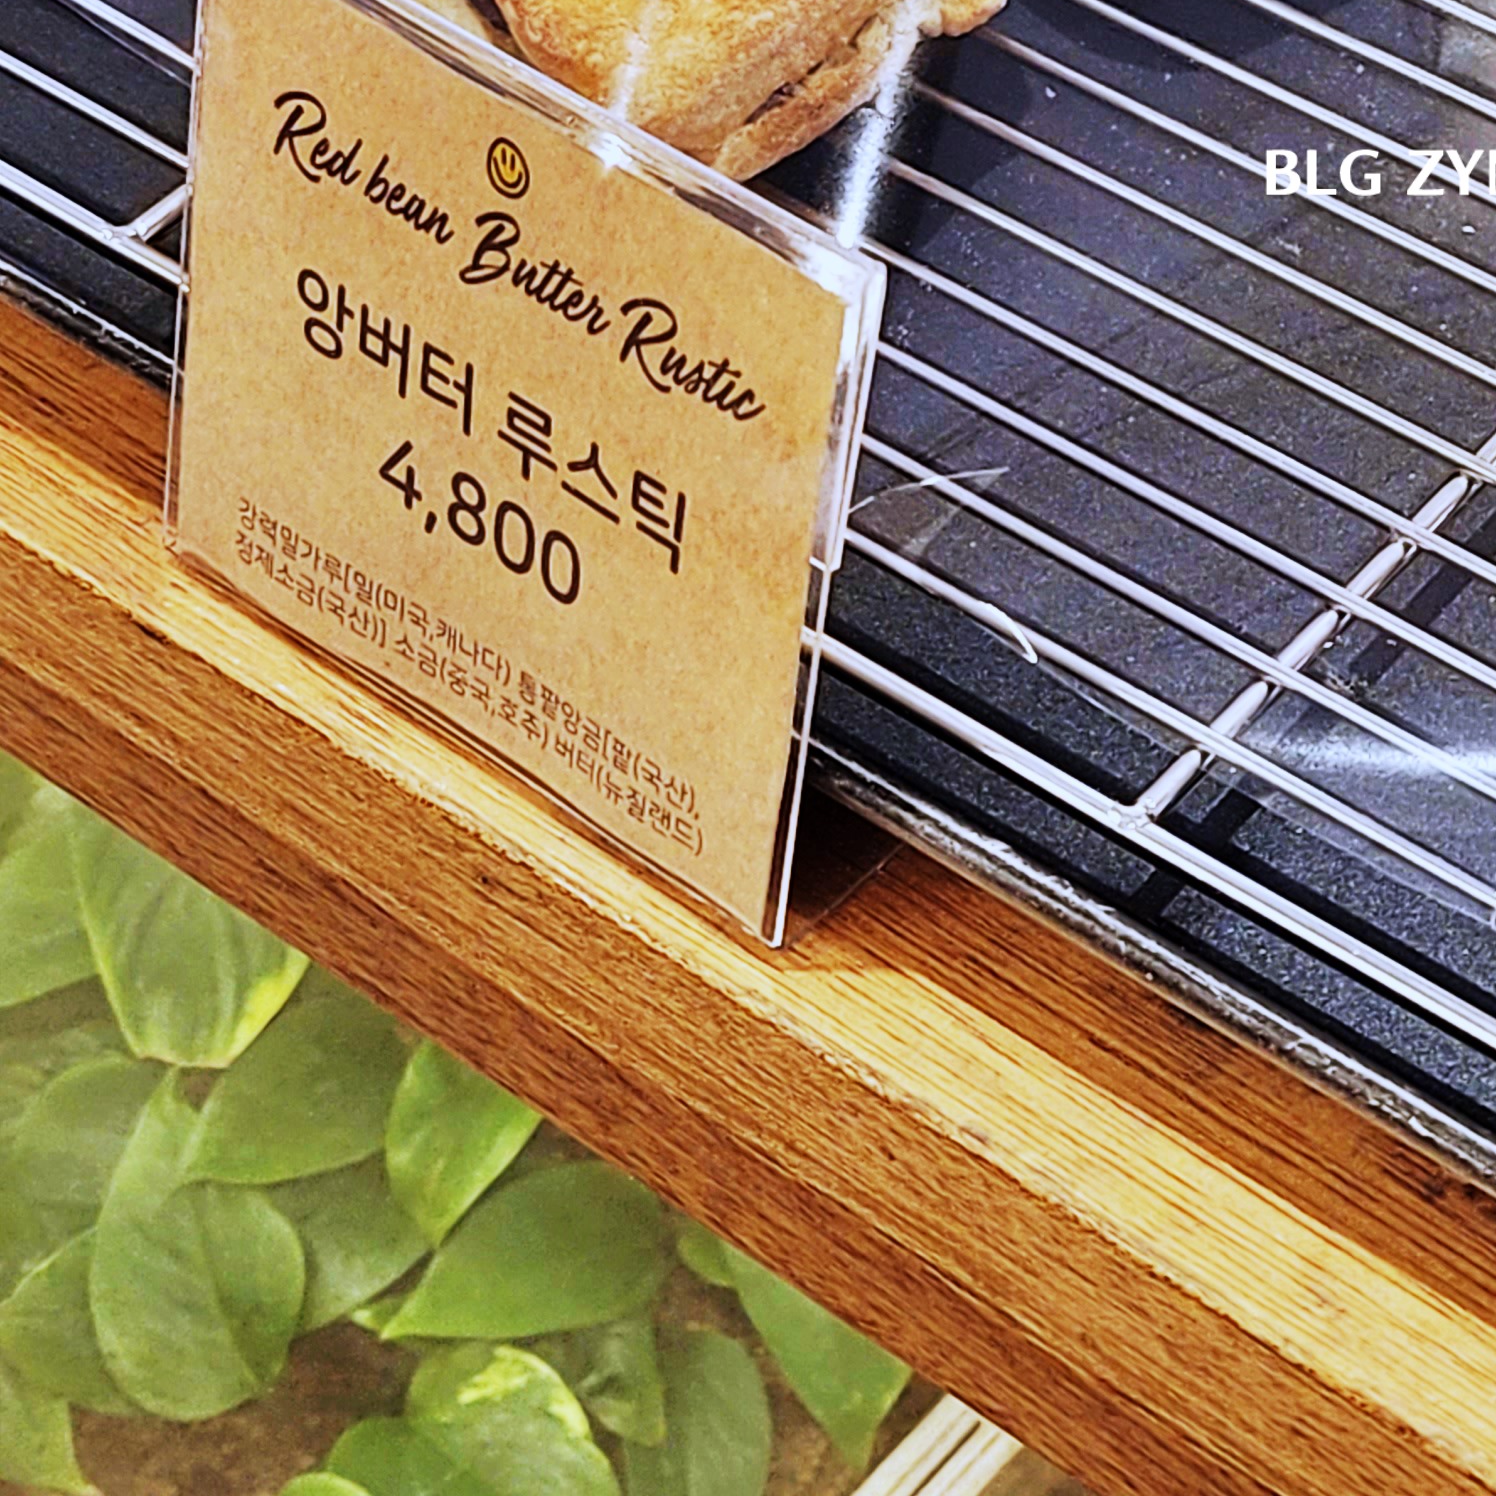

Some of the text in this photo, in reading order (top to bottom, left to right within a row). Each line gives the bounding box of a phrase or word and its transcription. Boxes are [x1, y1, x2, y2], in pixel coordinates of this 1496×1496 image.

[273, 89, 767, 423] Red bean Butter Rustic
[297, 267, 688, 576] 앙버터 루스틱
[377, 440, 581, 606] 4,800
[553, 732, 704, 858] 버터(뉴질랜드)
